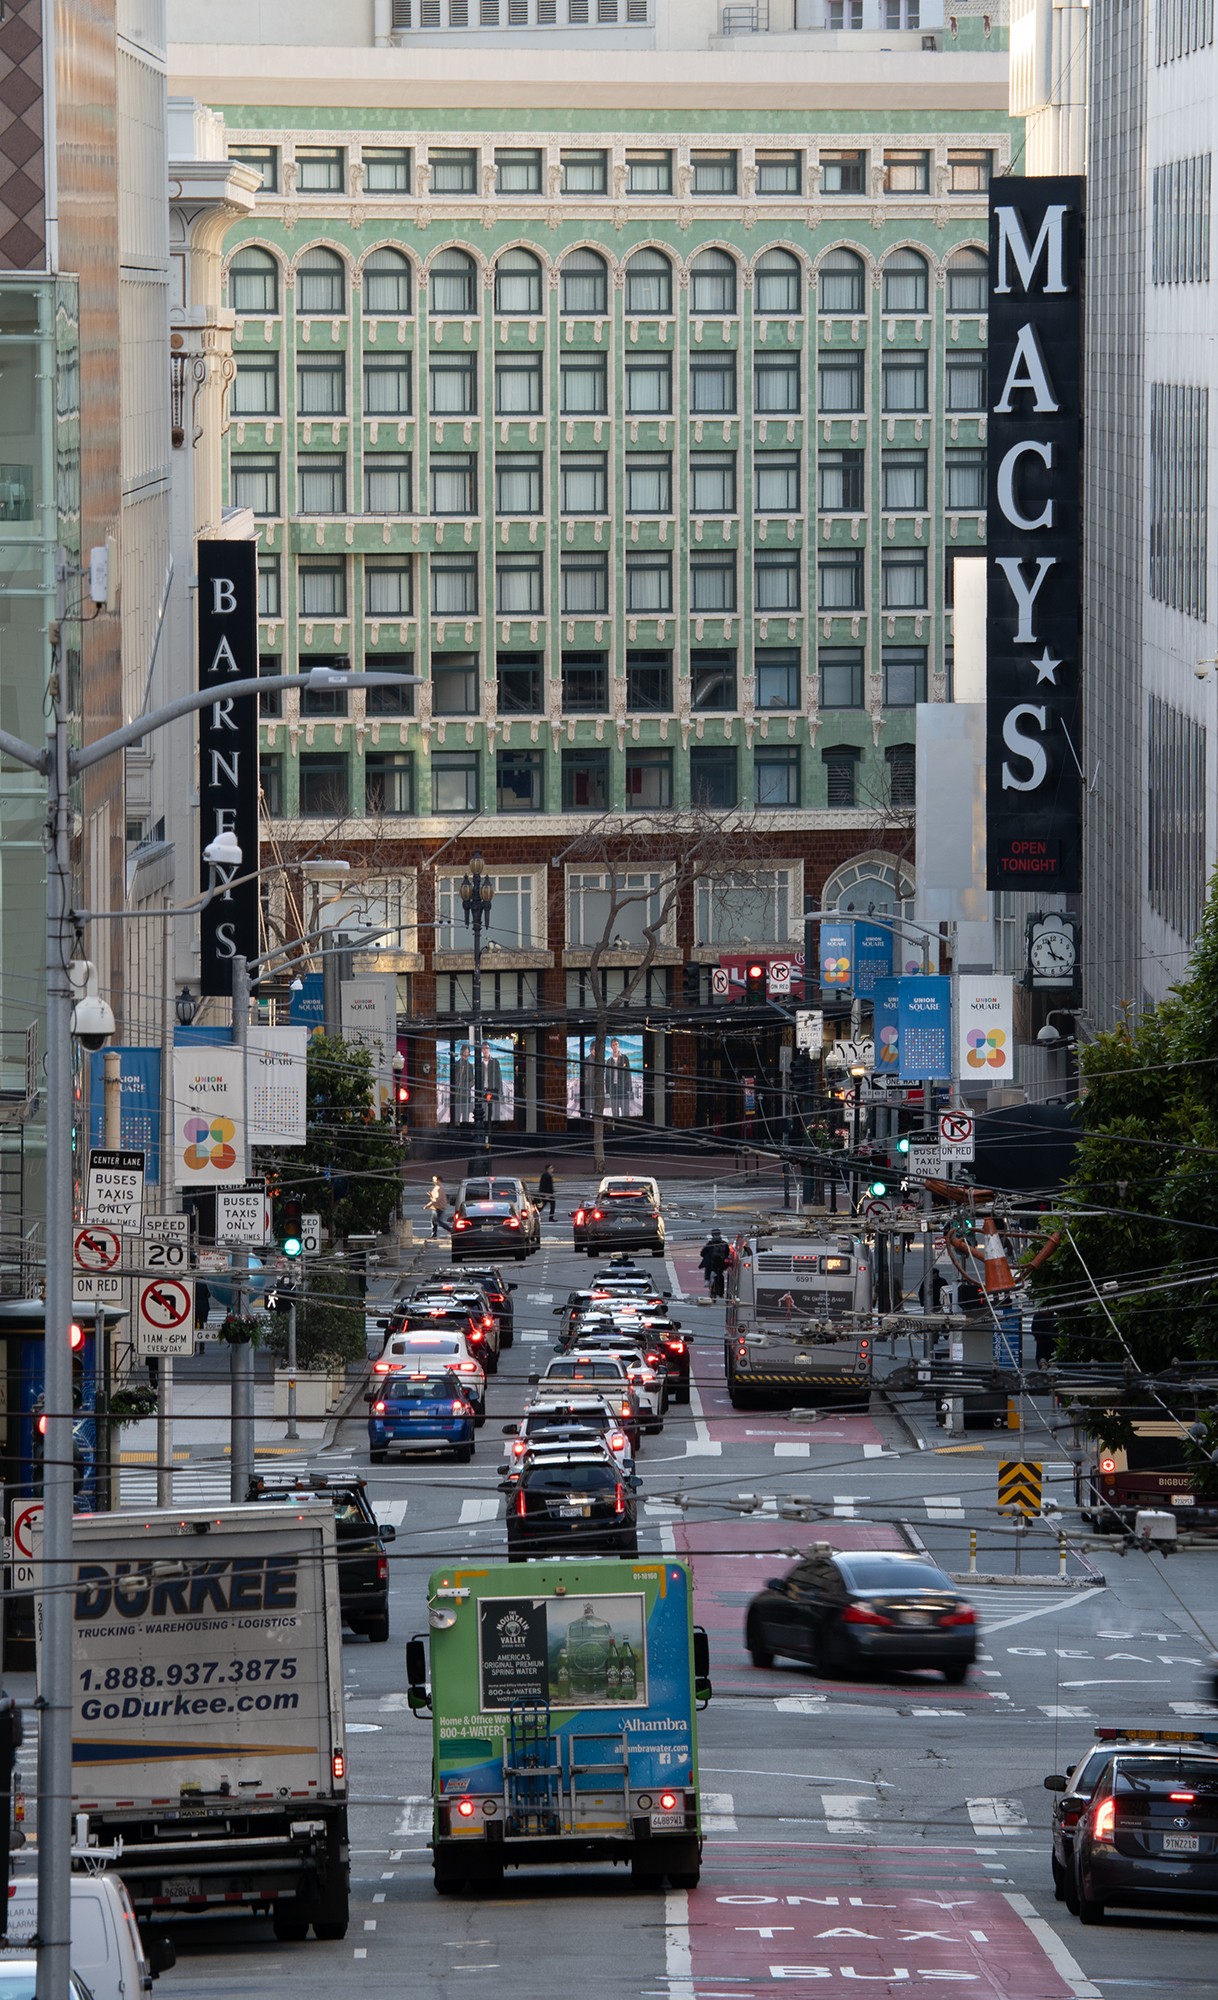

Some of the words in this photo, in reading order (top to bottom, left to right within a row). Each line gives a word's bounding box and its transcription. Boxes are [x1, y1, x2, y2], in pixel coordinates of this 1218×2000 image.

[1011, 841, 1046, 855] OPEN
[1001, 857, 1057, 871] TONIGHT
[349, 1003, 376, 1011] SQUARE
[908, 1002, 941, 1011] SQUARE
[970, 1003, 1001, 1011] SQUARE
[259, 1057, 294, 1067] SQUARE
[194, 1075, 223, 1083] UNION
[887, 1078, 900, 1086] ONE
[188, 1083, 229, 1095] SQUARE
[941, 1146, 953, 1155] ON
[955, 1146, 972, 1155] RED
[93, 1156, 120, 1166] CENTER
[122, 1157, 141, 1166] LANE
[915, 1157, 941, 1165] TAXIS
[915, 1167, 940, 1175] ONLY
[95, 1174, 137, 1185] BUSES
[97, 1189, 134, 1200] TAXIS
[223, 1197, 259, 1206] BUSES
[98, 1203, 132, 1214] ONLY
[225, 1210, 257, 1218] TAXIS
[116, 1219, 137, 1227] TIMES
[147, 1220, 185, 1231] SPEED
[226, 1221, 256, 1230] ONLY
[304, 1236, 317, 1251] 0
[148, 1244, 184, 1266] 20
[77, 1280, 95, 1292] ON
[97, 1279, 118, 1291] RED
[143, 1334, 162, 1344] 11AM
[169, 1333, 187, 1344] 6PM
[74, 1554, 299, 1621] DURKEE
[78, 1625, 136, 1639] TRUCKING
[145, 1620, 228, 1634] WAREHOUSING
[238, 1617, 297, 1629] LOGISTICS
[496, 1614, 530, 1631] MOUNTAIN
[500, 1636, 526, 1644] VALLEY
[496, 1653, 531, 1661] AMERICA'S
[1006, 1646, 1207, 1667] GEAR
[484, 1661, 514, 1669] ORIGINAL
[515, 1660, 544, 1668] PREMIUM
[79, 1658, 298, 1691] 1.888.937.3875
[491, 1668, 515, 1676] SPRING
[516, 1667, 538, 1675] WATER
[488, 1687, 542, 1696] 800-4-WATERS
[81, 1691, 299, 1721] GoDurkee.com
[440, 1716, 463, 1726] Home
[463, 1716, 470, 1725] &
[470, 1715, 493, 1725] Office
[622, 1717, 688, 1731] Alhambra
[440, 1725, 506, 1738] 800-4-WATERS
[1165, 1839, 1198, 1849] 9TNZ218
[715, 1894, 979, 1910] ONLY
[735, 1925, 990, 1943] TAXI
[768, 1964, 982, 1981] BUS
